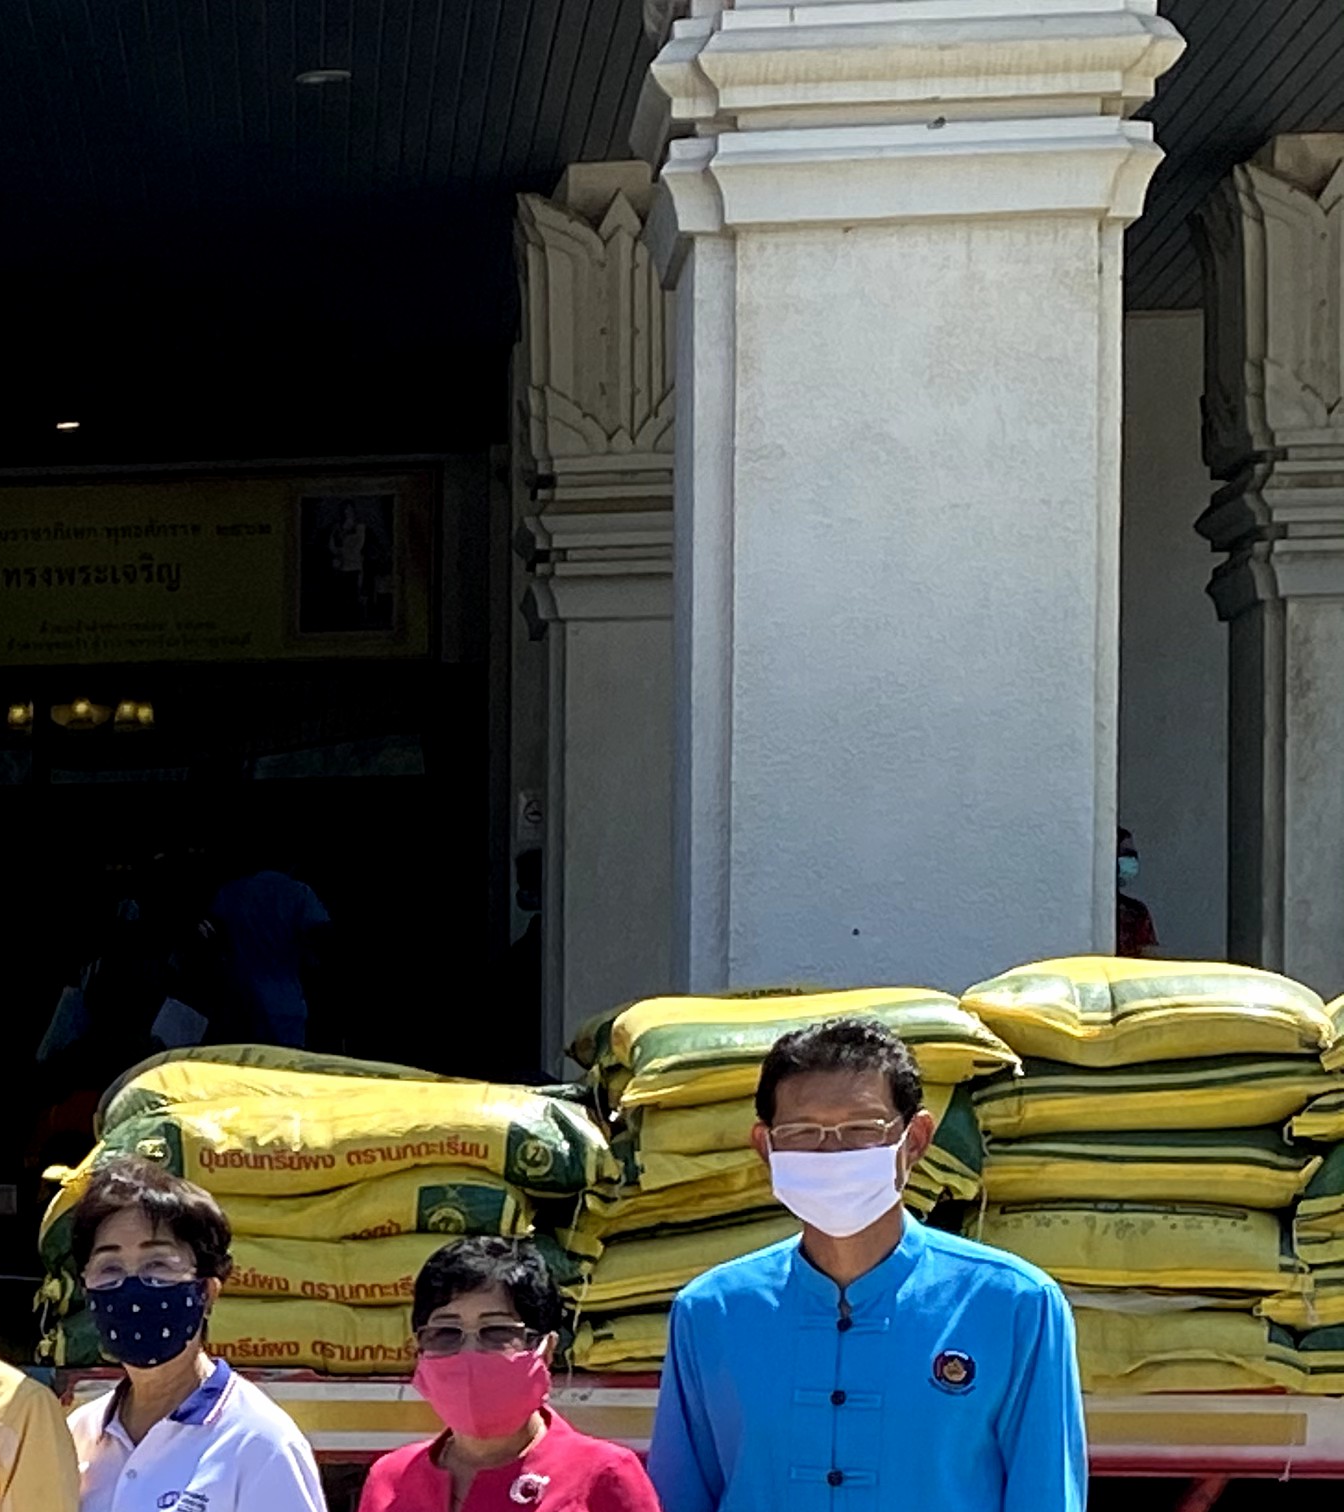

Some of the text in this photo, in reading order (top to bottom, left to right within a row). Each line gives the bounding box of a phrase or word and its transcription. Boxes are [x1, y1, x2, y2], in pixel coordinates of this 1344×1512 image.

[347, 1135, 489, 1168] ตรานกกะเรียน
